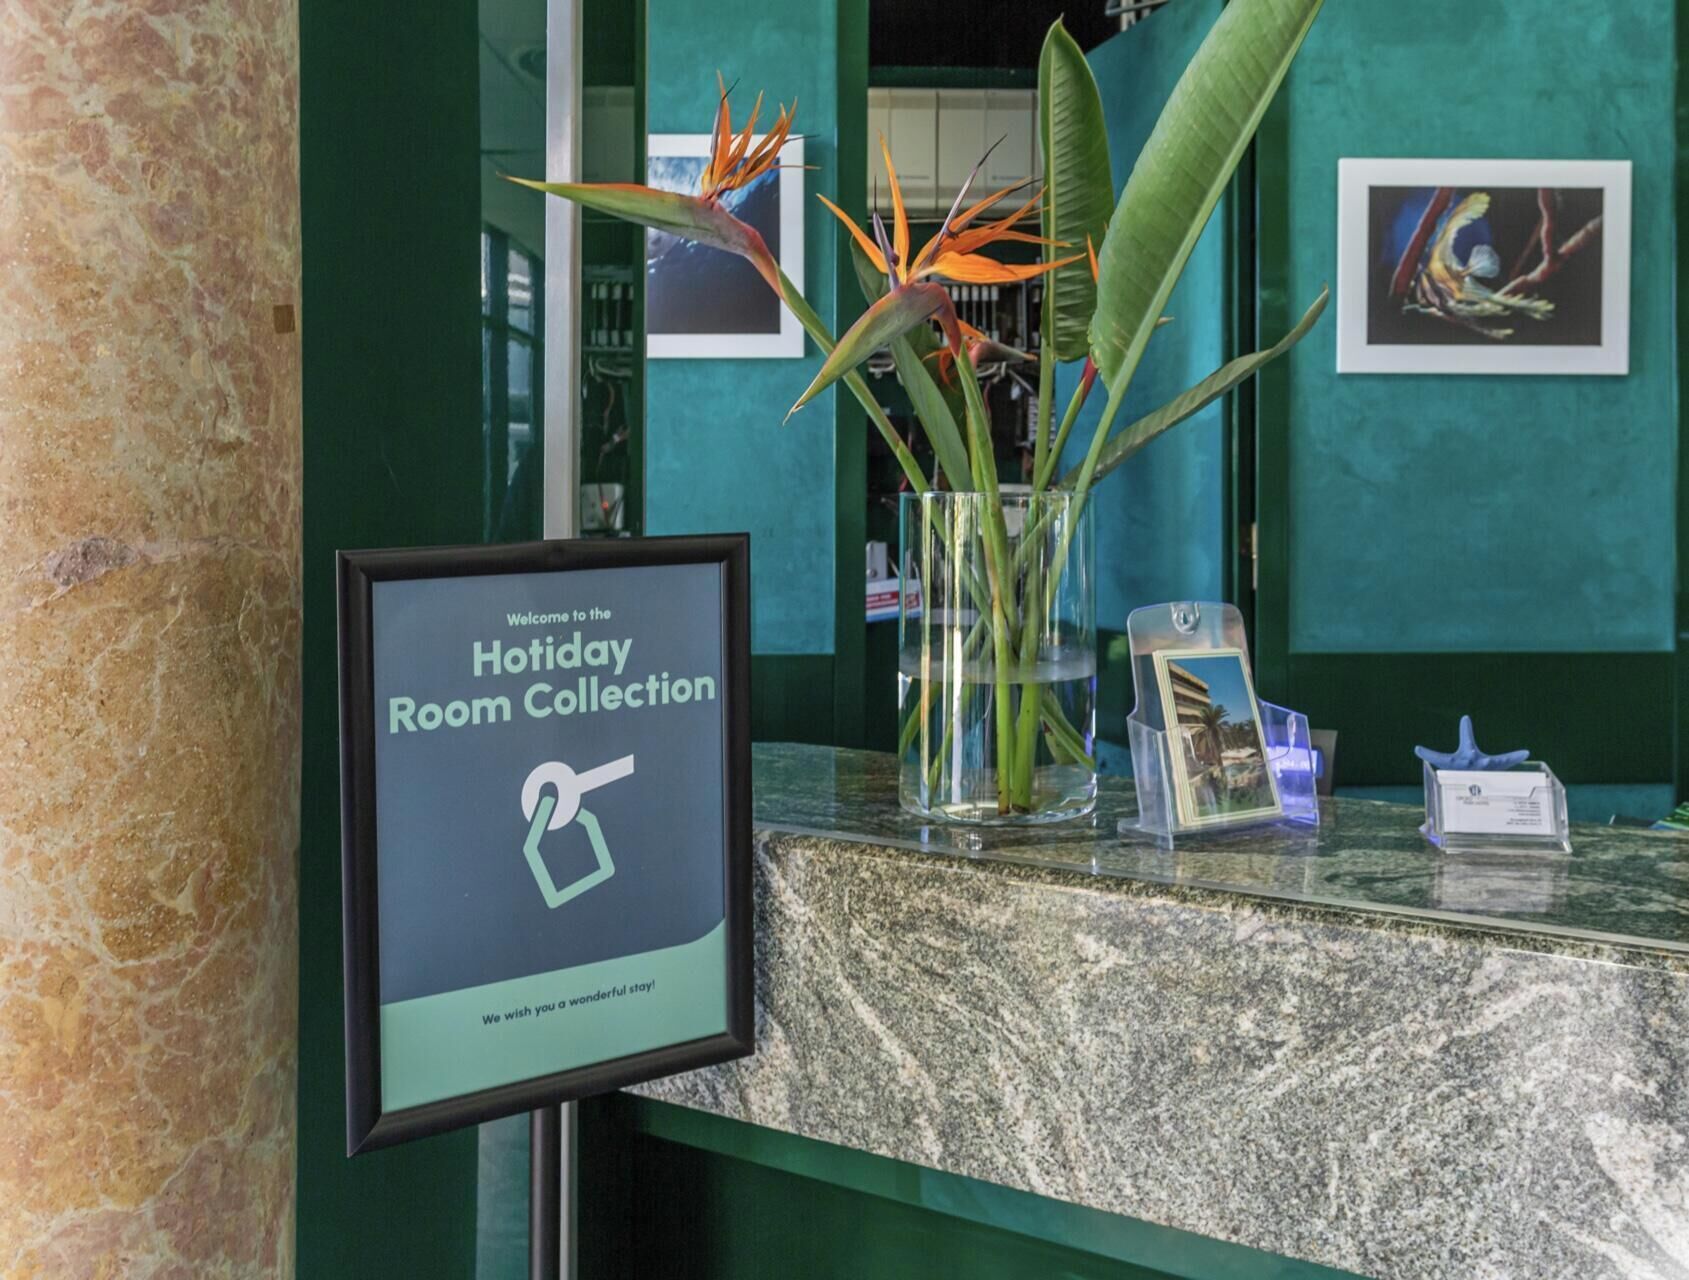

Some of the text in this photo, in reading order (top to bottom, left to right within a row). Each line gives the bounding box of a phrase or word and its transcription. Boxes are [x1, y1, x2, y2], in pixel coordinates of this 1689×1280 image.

[507, 606, 611, 626] Welcome to the
[473, 631, 632, 677] Hotiday
[389, 671, 716, 734] Room Collection
[482, 979, 656, 1025] We wish you a wonderful stay!
